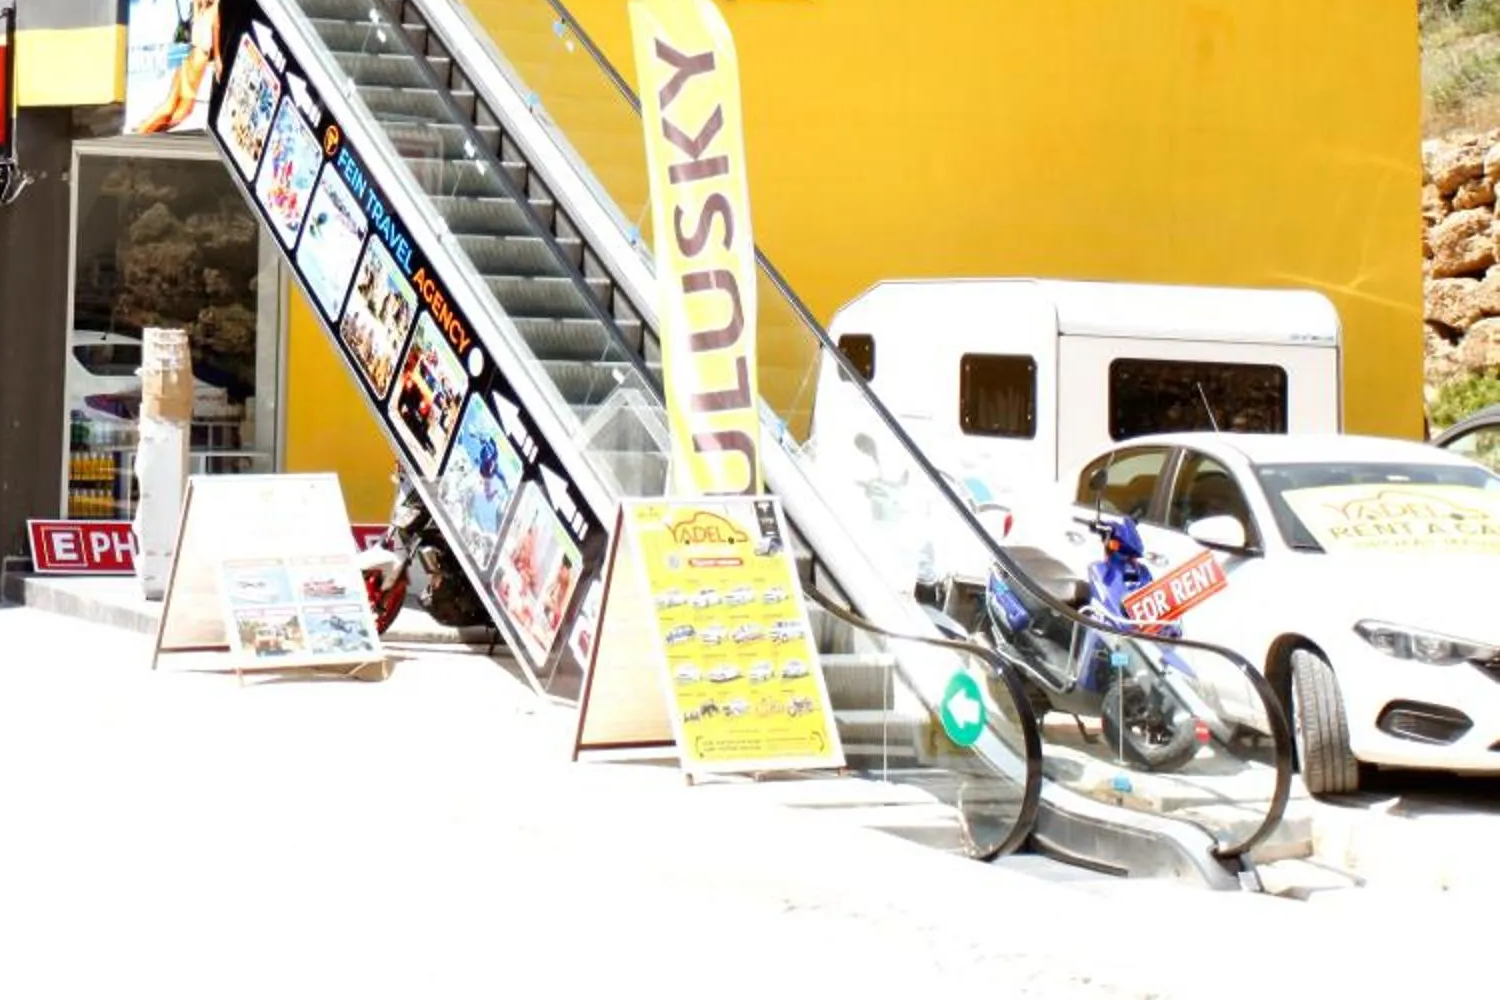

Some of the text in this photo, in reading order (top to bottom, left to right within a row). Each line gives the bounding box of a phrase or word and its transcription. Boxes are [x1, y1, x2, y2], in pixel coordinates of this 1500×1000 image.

[336, 150, 471, 352] FEIN TRAVEL AGENCY
[51, 531, 135, 563] E PH
[1131, 558, 1217, 628] FOR RENT
